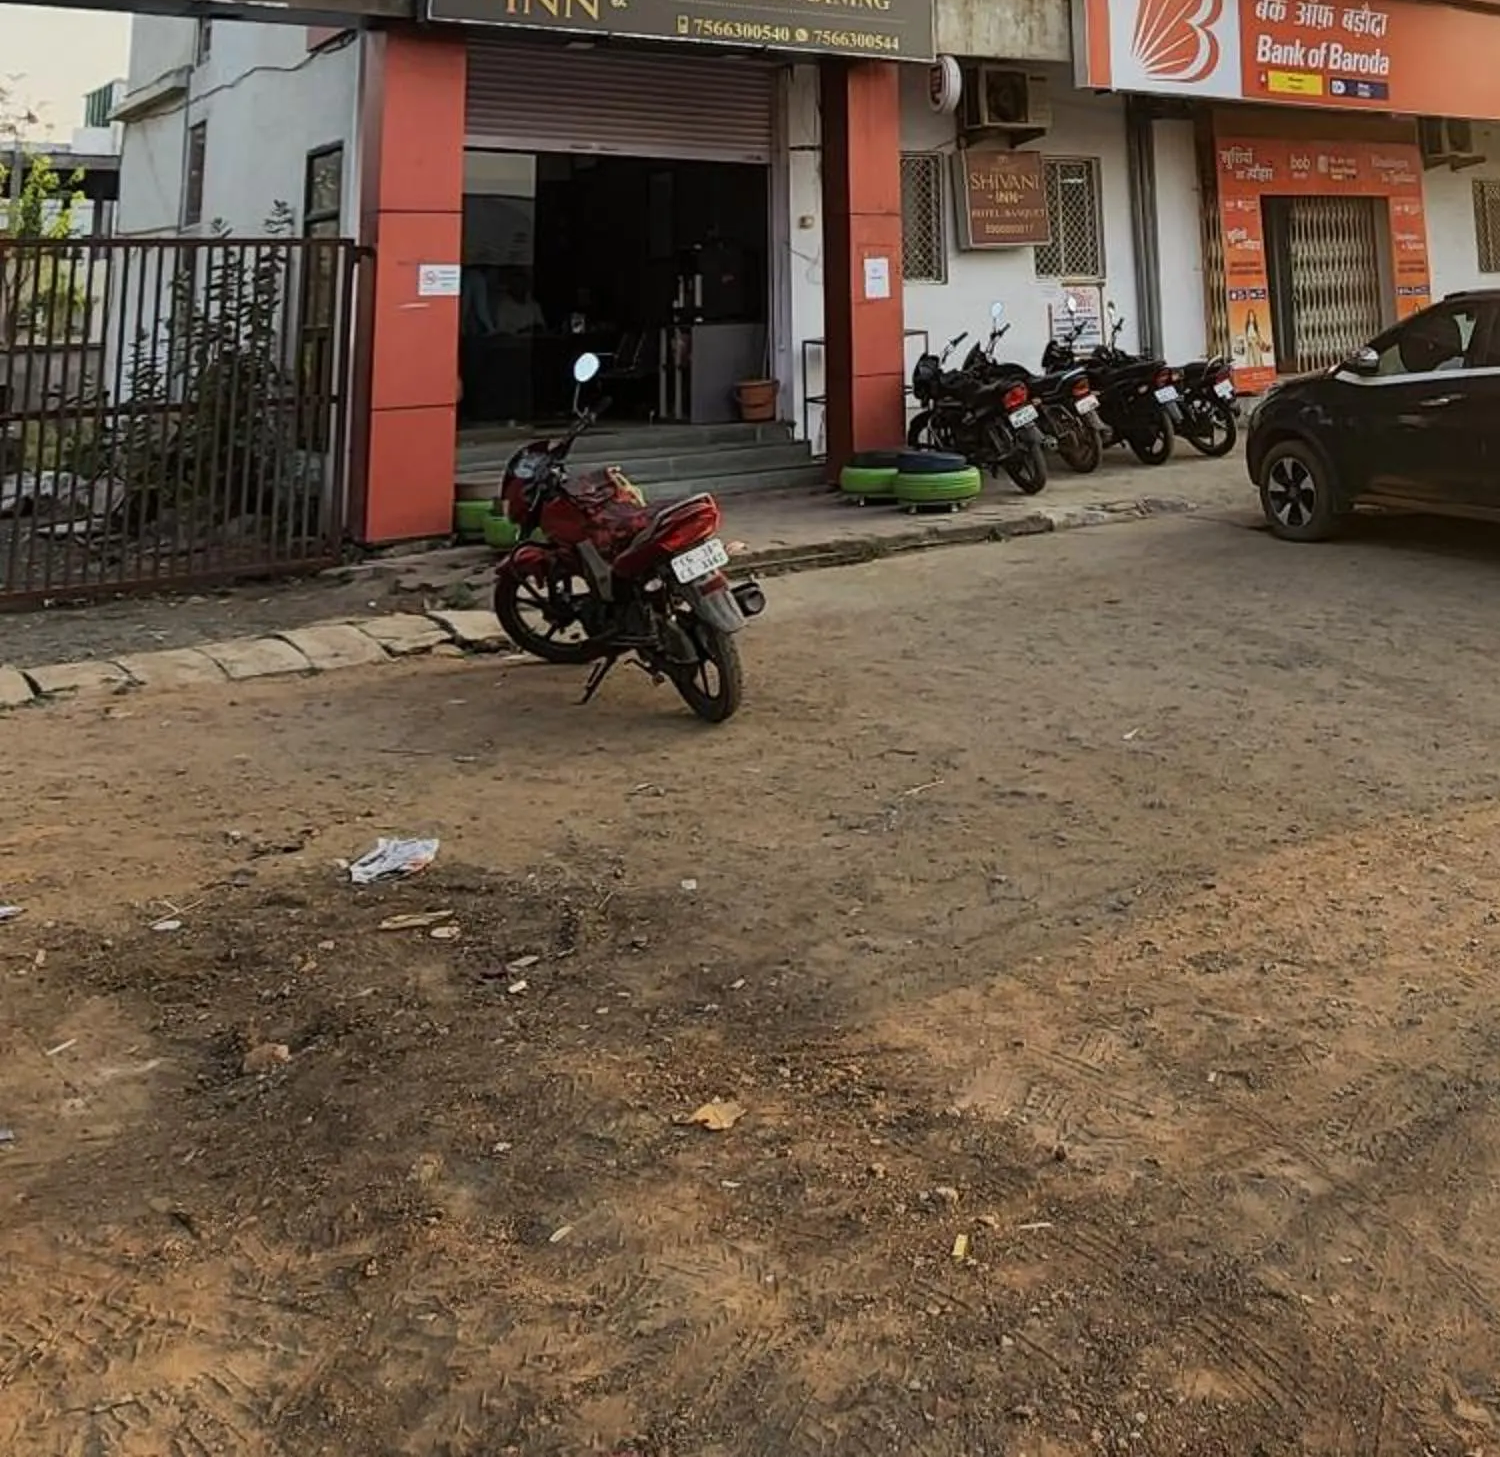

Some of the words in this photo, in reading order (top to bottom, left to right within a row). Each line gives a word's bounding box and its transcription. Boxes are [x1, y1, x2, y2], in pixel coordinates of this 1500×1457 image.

[693, 18, 790, 42] 7566300540
[814, 30, 899, 52] 7566300544
[1342, 1, 1389, 39] बड़ौदा
[1256, 34, 1306, 68] Bank
[1307, 41, 1328, 69] of
[1328, 42, 1390, 76] Baroda
[1289, 153, 1311, 171] bob
[969, 173, 1040, 191] SHIVANI
